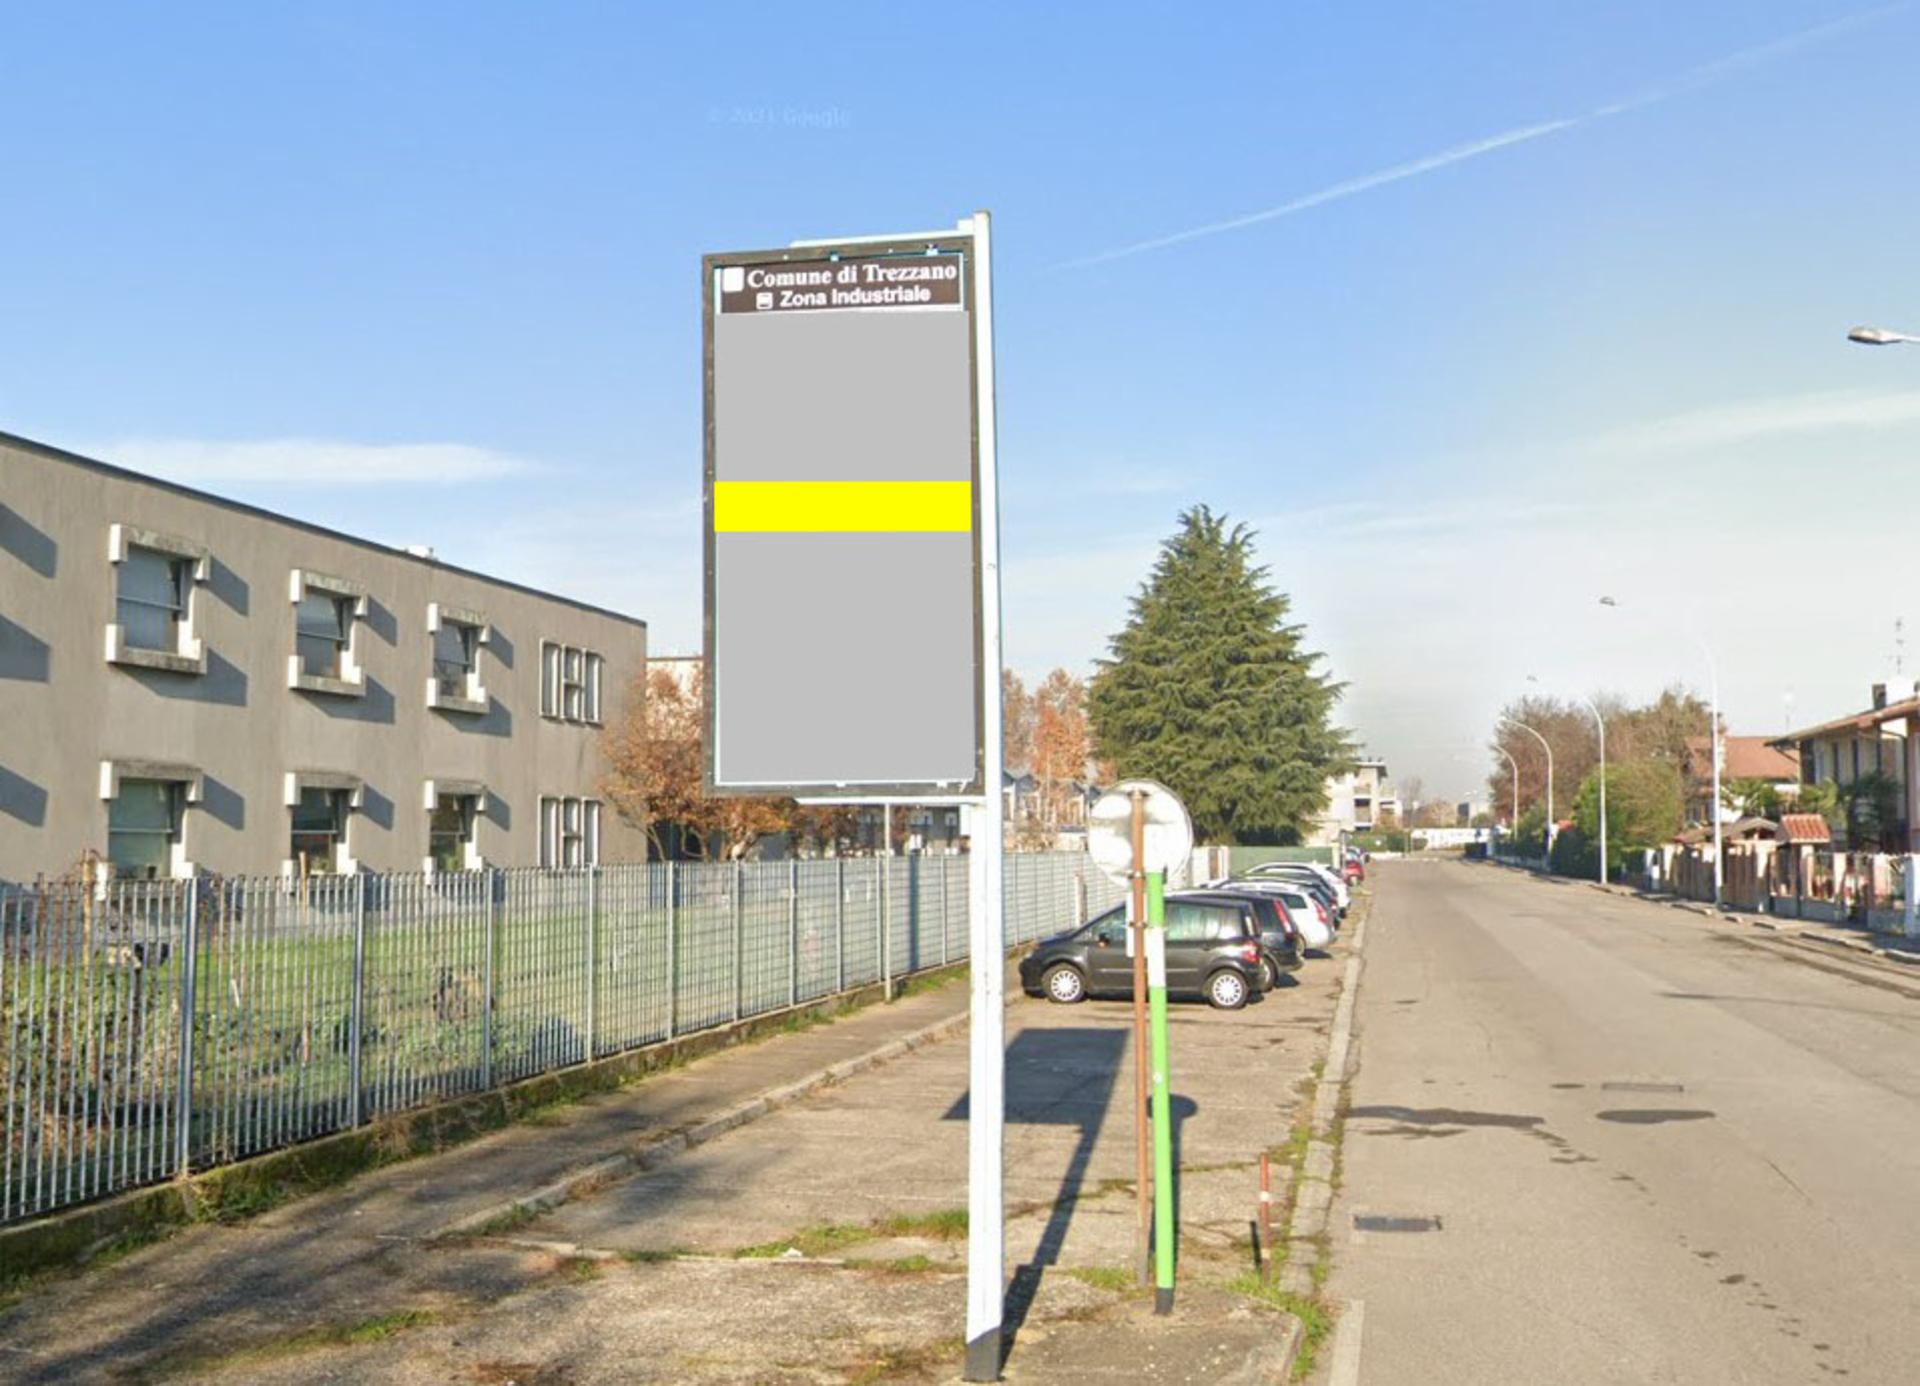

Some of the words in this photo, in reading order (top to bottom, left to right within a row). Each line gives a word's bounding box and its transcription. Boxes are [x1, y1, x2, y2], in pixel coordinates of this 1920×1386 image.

[747, 268, 832, 288] Comune
[838, 267, 857, 285] di
[863, 263, 957, 283] Trezzano
[779, 290, 827, 307] Zona
[832, 285, 932, 305] Industriale
